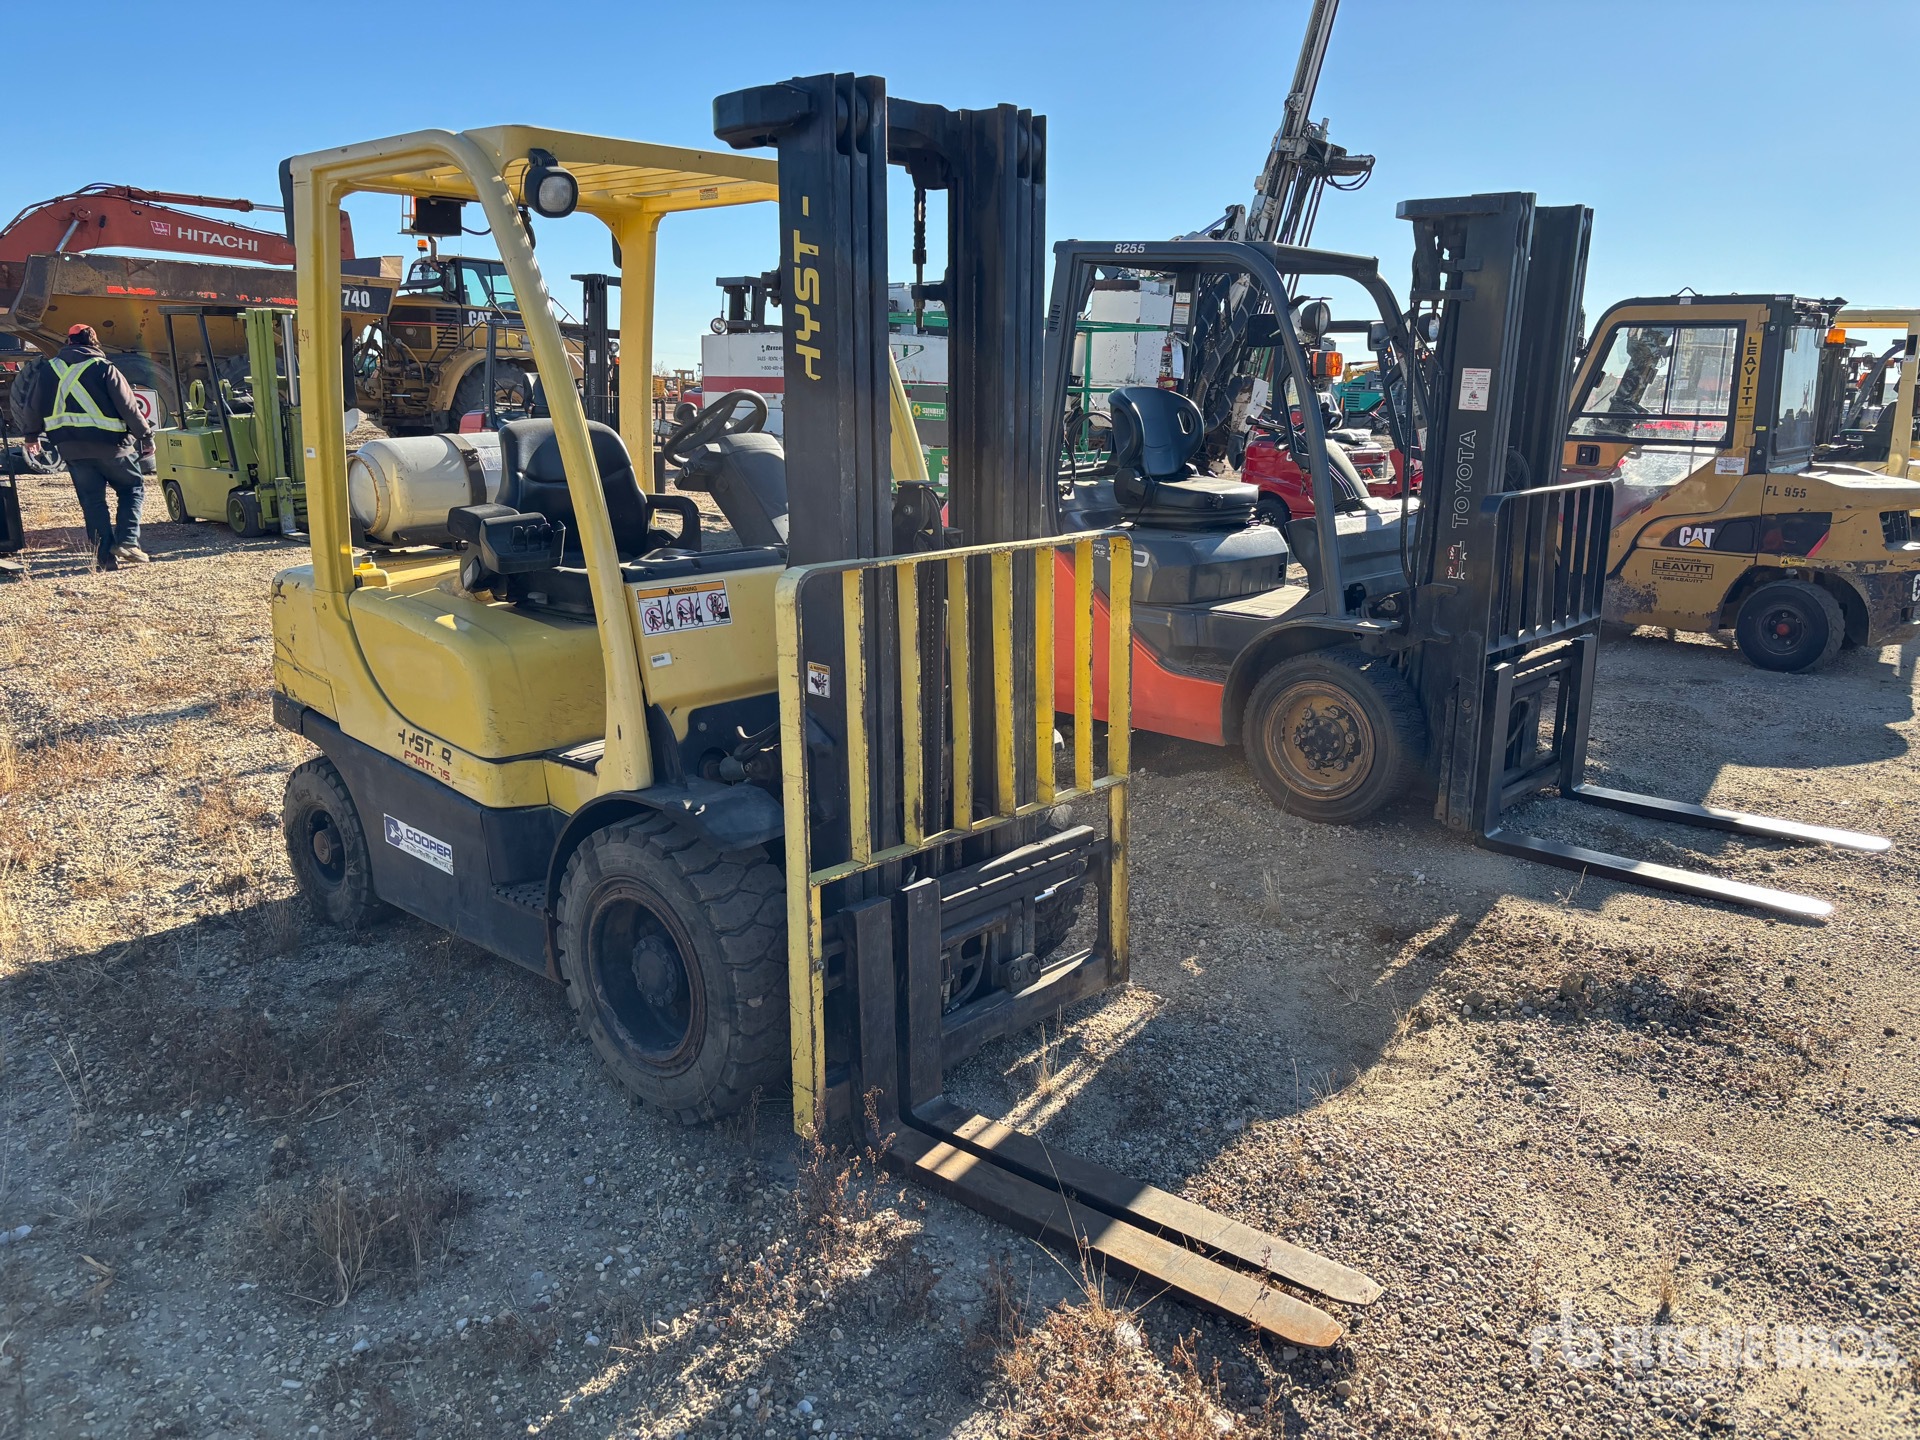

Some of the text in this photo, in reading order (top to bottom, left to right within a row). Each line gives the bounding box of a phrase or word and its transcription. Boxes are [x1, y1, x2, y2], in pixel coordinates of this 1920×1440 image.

[177, 226, 259, 252] HITACHI
[1114, 243, 1146, 254] 8255
[341, 289, 371, 308] 740
[468, 310, 493, 327] CAT
[1741, 336, 1758, 406] LEAVITT
[1451, 429, 1477, 529] TOYOTA
[1765, 485, 1807, 499] FL 955
[1678, 526, 1716, 549] CAT
[1654, 562, 1711, 573] LEAVITT
[406, 828, 452, 860] COOPER
